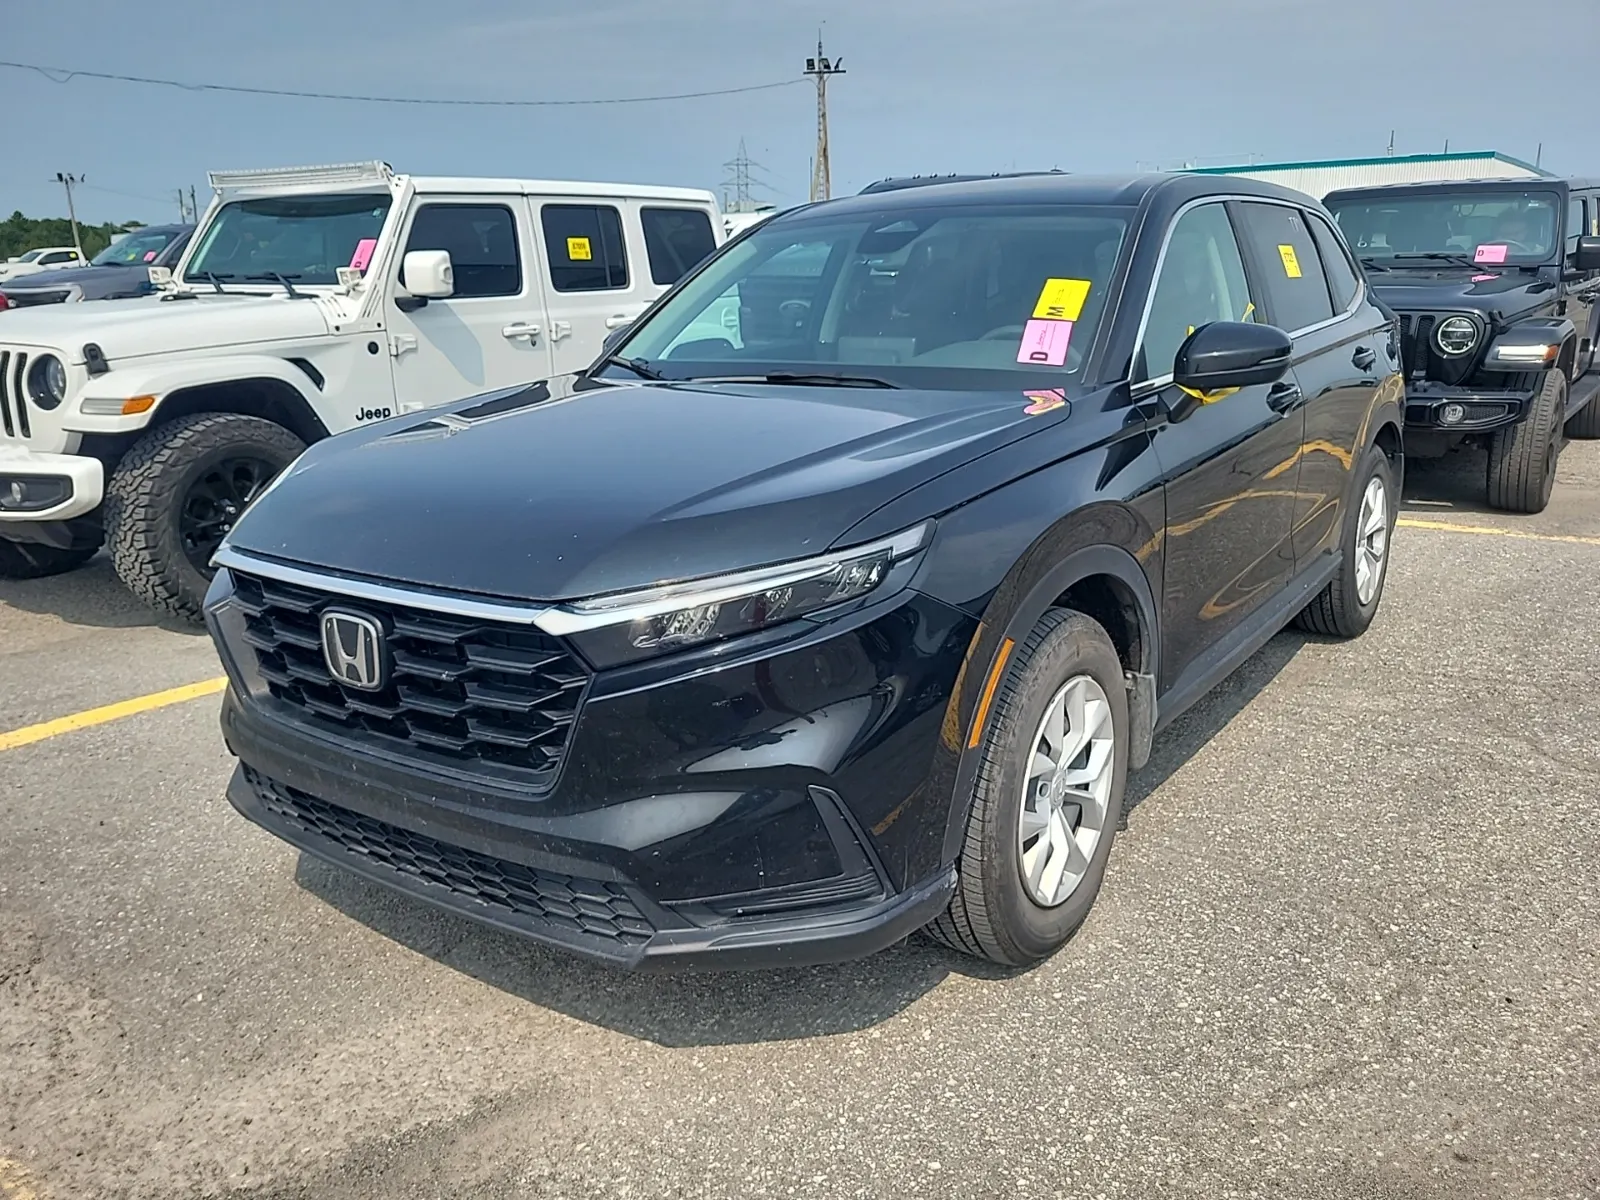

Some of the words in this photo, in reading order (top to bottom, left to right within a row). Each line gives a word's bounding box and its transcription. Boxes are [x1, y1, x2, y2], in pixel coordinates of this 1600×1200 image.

[1046, 306, 1065, 317] M
[1029, 351, 1048, 361] D
[355, 407, 391, 421] Jeep
